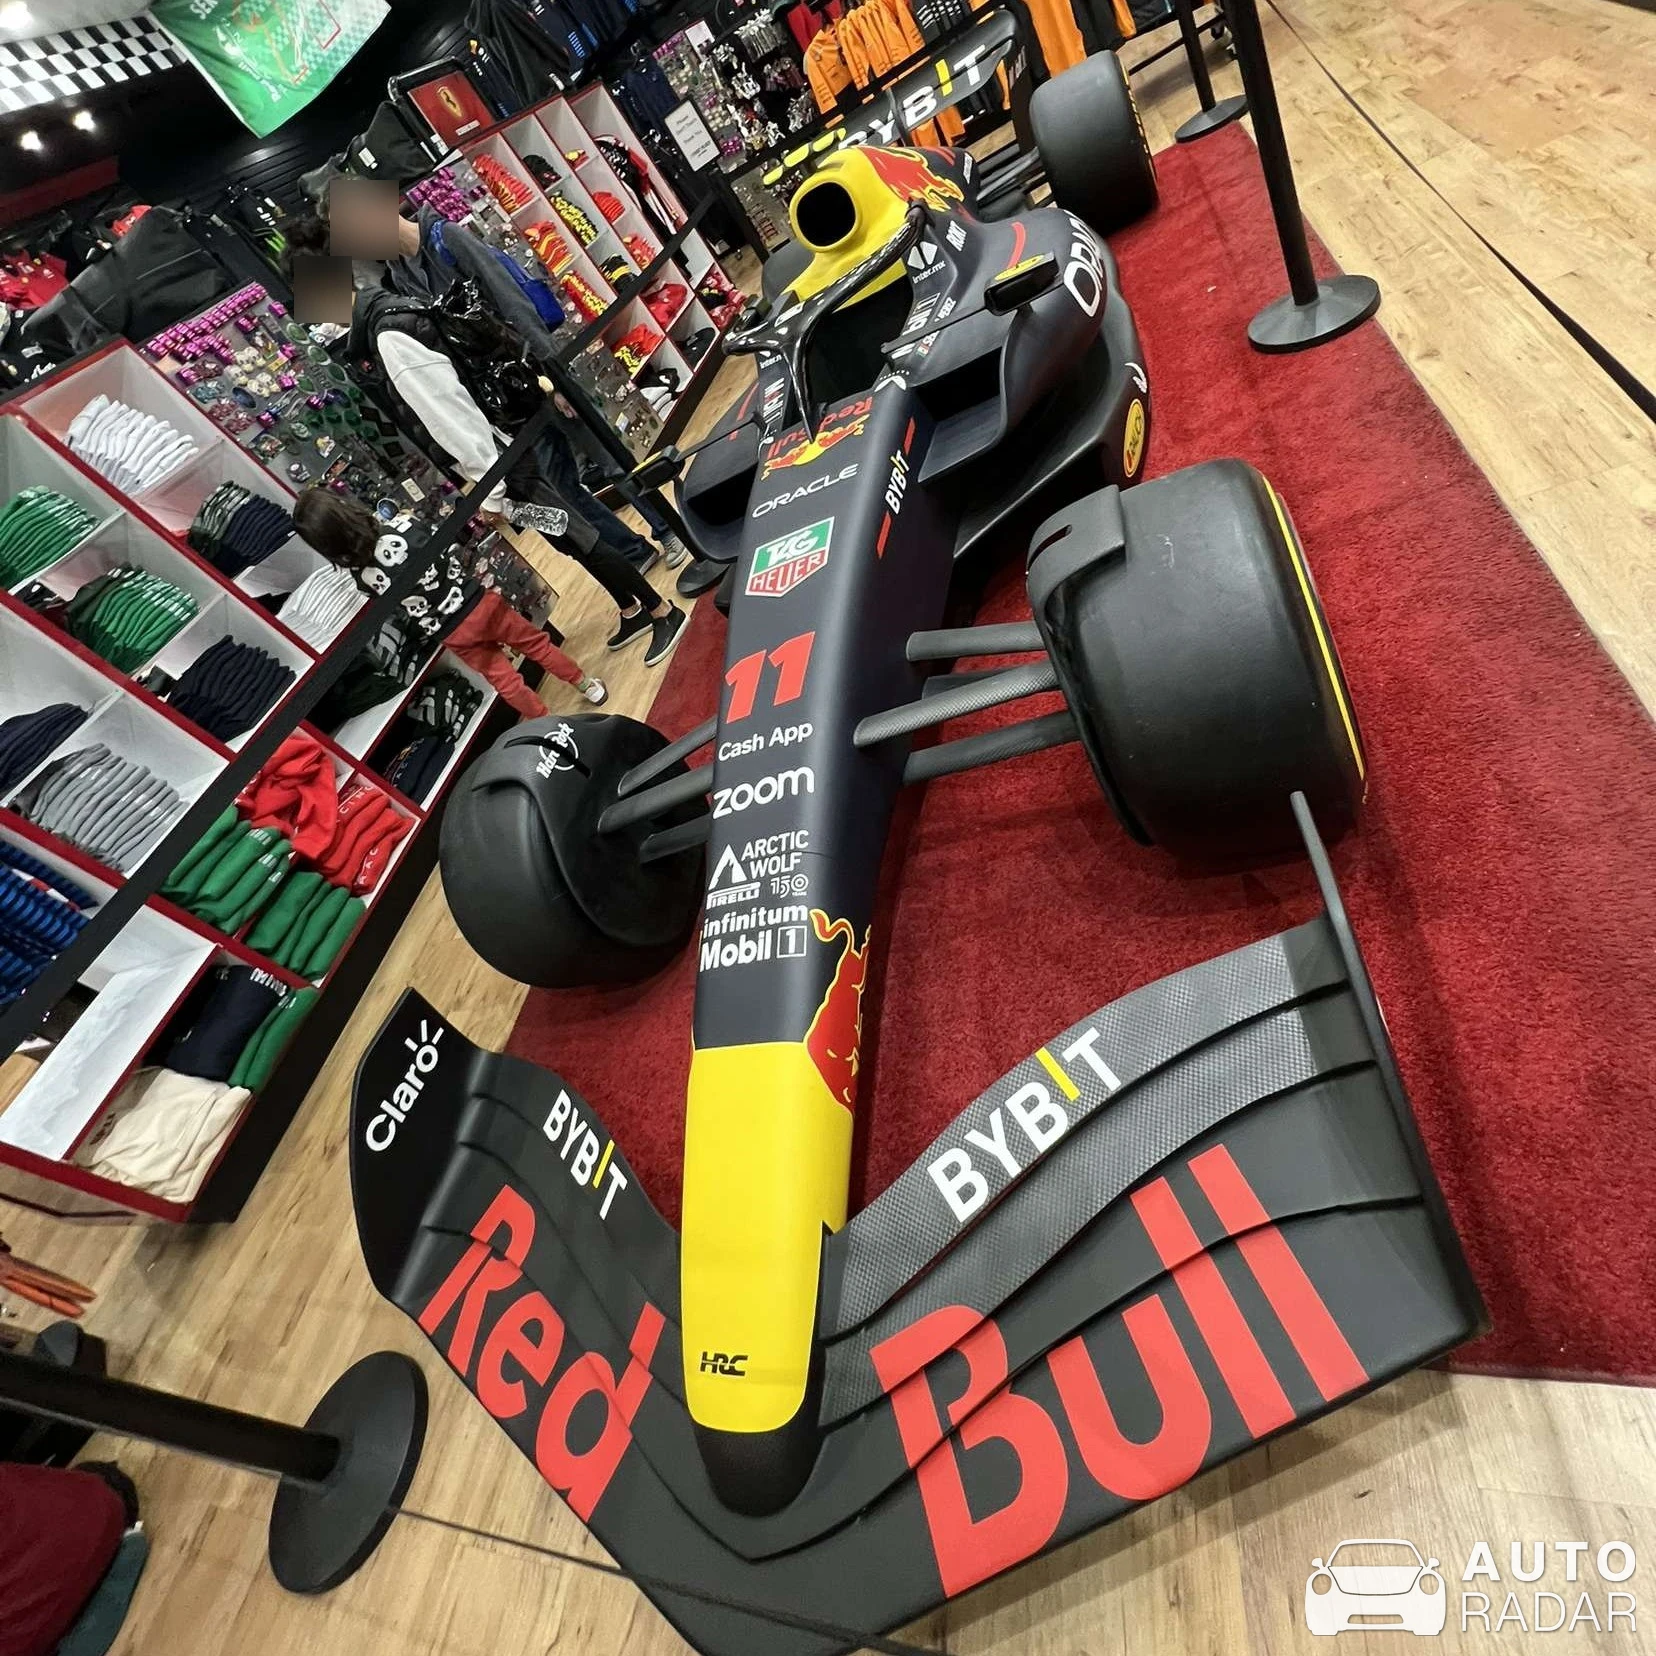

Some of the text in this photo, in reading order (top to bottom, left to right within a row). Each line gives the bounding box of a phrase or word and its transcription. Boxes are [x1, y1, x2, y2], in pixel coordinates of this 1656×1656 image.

[752, 463, 859, 518] ORACLE
[884, 449, 910, 515] BYBIT
[751, 551, 822, 592] HEUER
[766, 529, 819, 568] TAG
[725, 631, 816, 725] 11
[718, 722, 814, 762] Cash App
[712, 766, 815, 819] zoom
[741, 829, 809, 861] ARCTIC
[749, 851, 803, 880] WOLF
[706, 881, 761, 911] PIRELLI
[703, 904, 808, 940] infinitum
[700, 929, 773, 973] Mobil
[365, 1032, 441, 1153] Claro
[925, 1026, 1122, 1224] BYBIT
[542, 1088, 628, 1221] BYBIT
[418, 1184, 667, 1523] Red
[699, 1350, 749, 1377] HRC
[868, 1143, 1371, 1599] Bull
